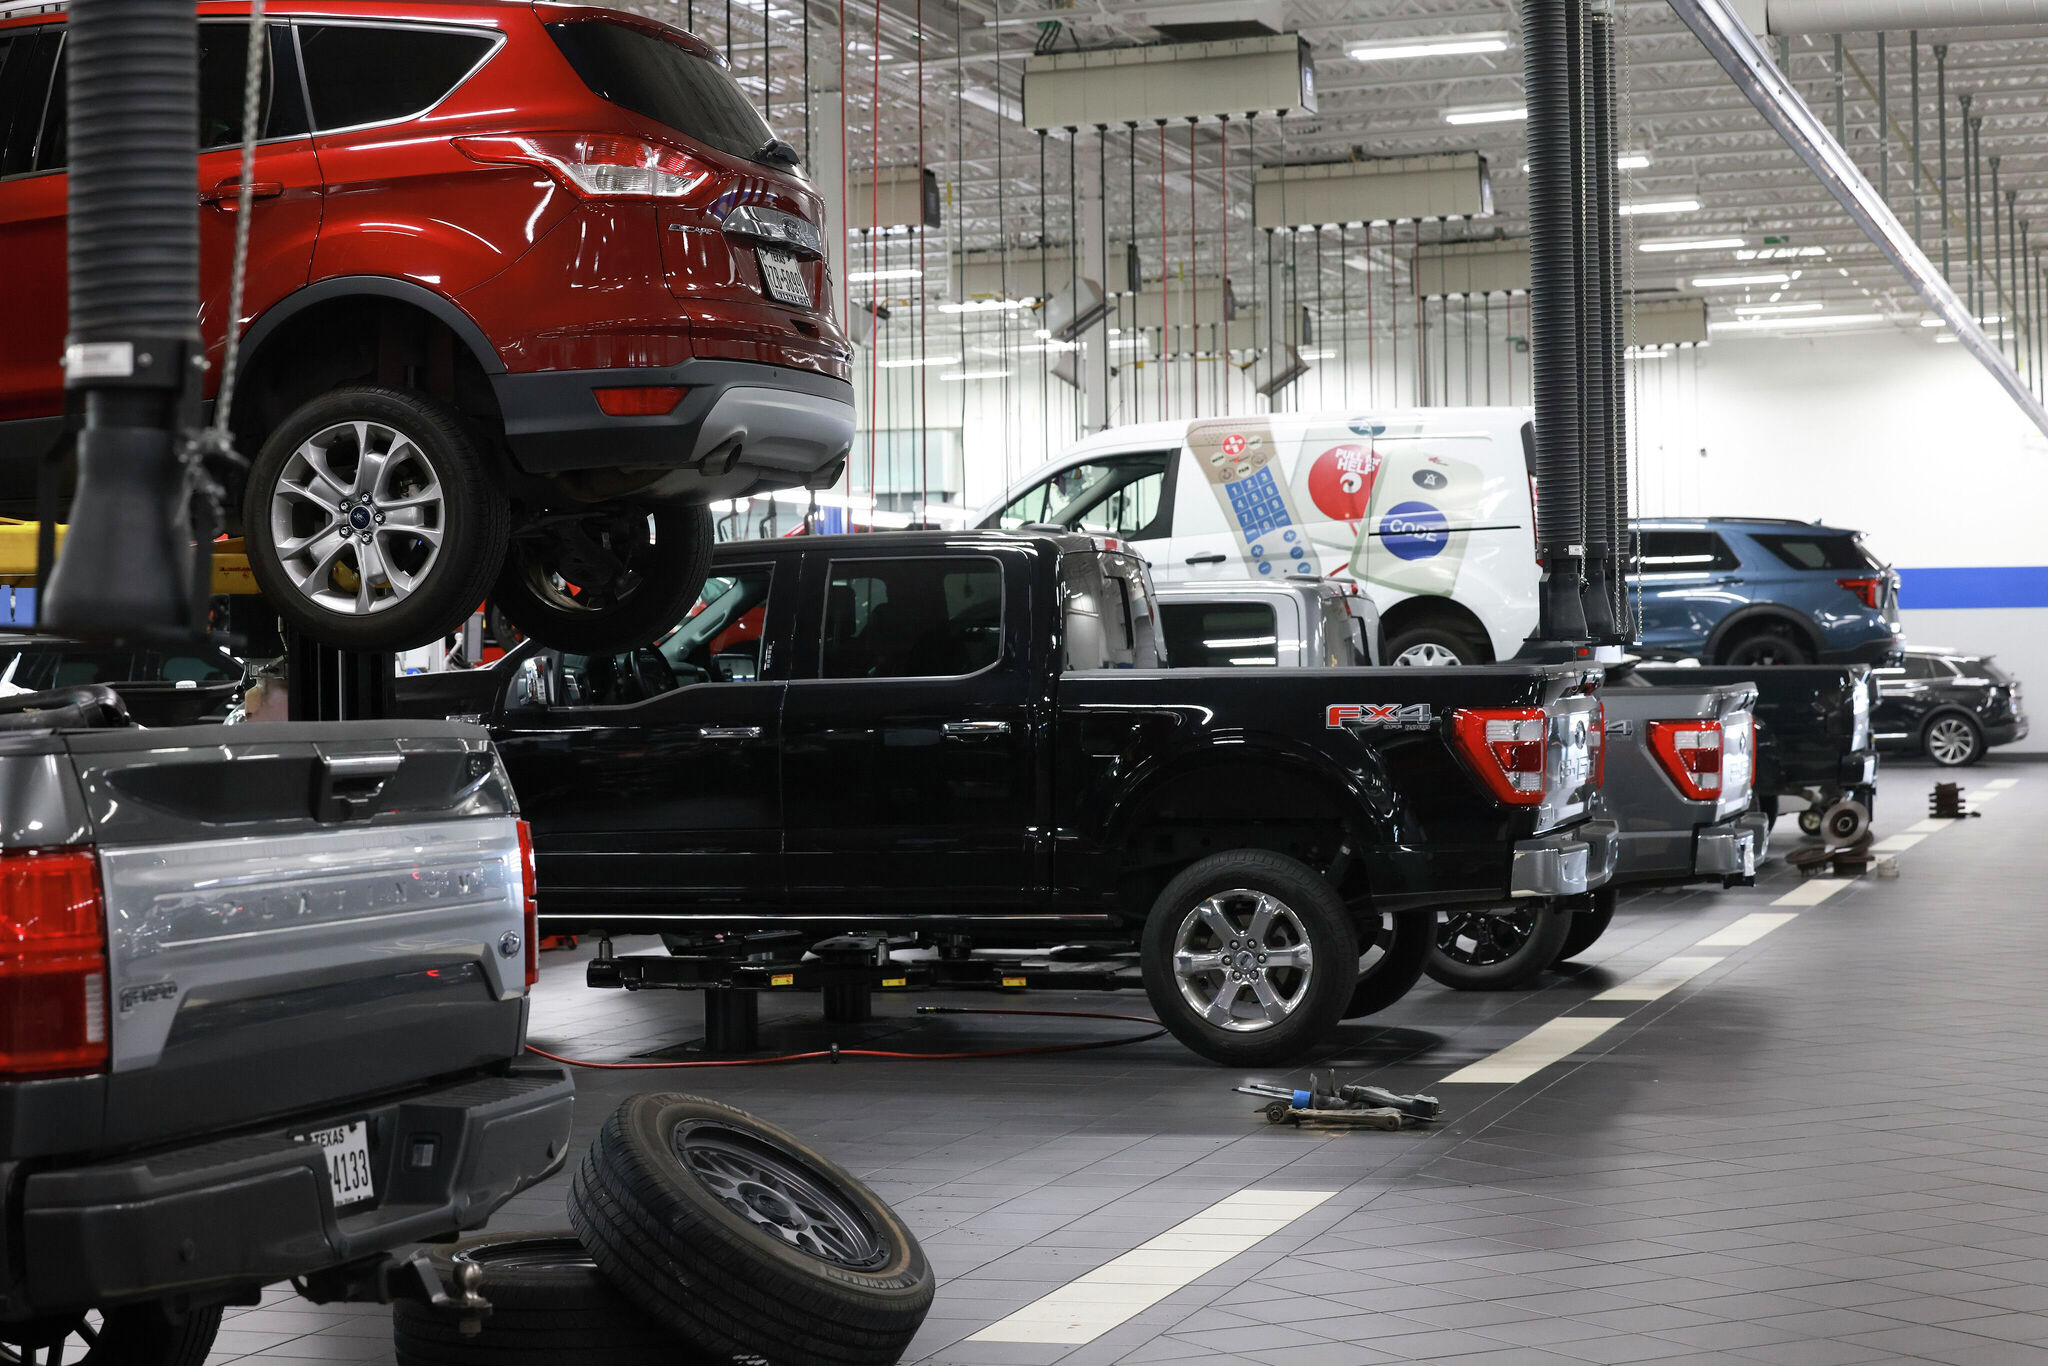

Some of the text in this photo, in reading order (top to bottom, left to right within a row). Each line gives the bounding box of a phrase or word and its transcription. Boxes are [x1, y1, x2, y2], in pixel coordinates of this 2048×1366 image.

[1335, 447, 1362, 462] PULL
[1337, 457, 1376, 475] HELP
[1245, 479, 1254, 488] 2
[1250, 493, 1259, 502] 5
[1266, 486, 1273, 495] 6
[1256, 506, 1265, 516] 8
[1271, 500, 1279, 509] 9
[1389, 518, 1438, 542] CODE
[1325, 703, 1431, 729] FX4
